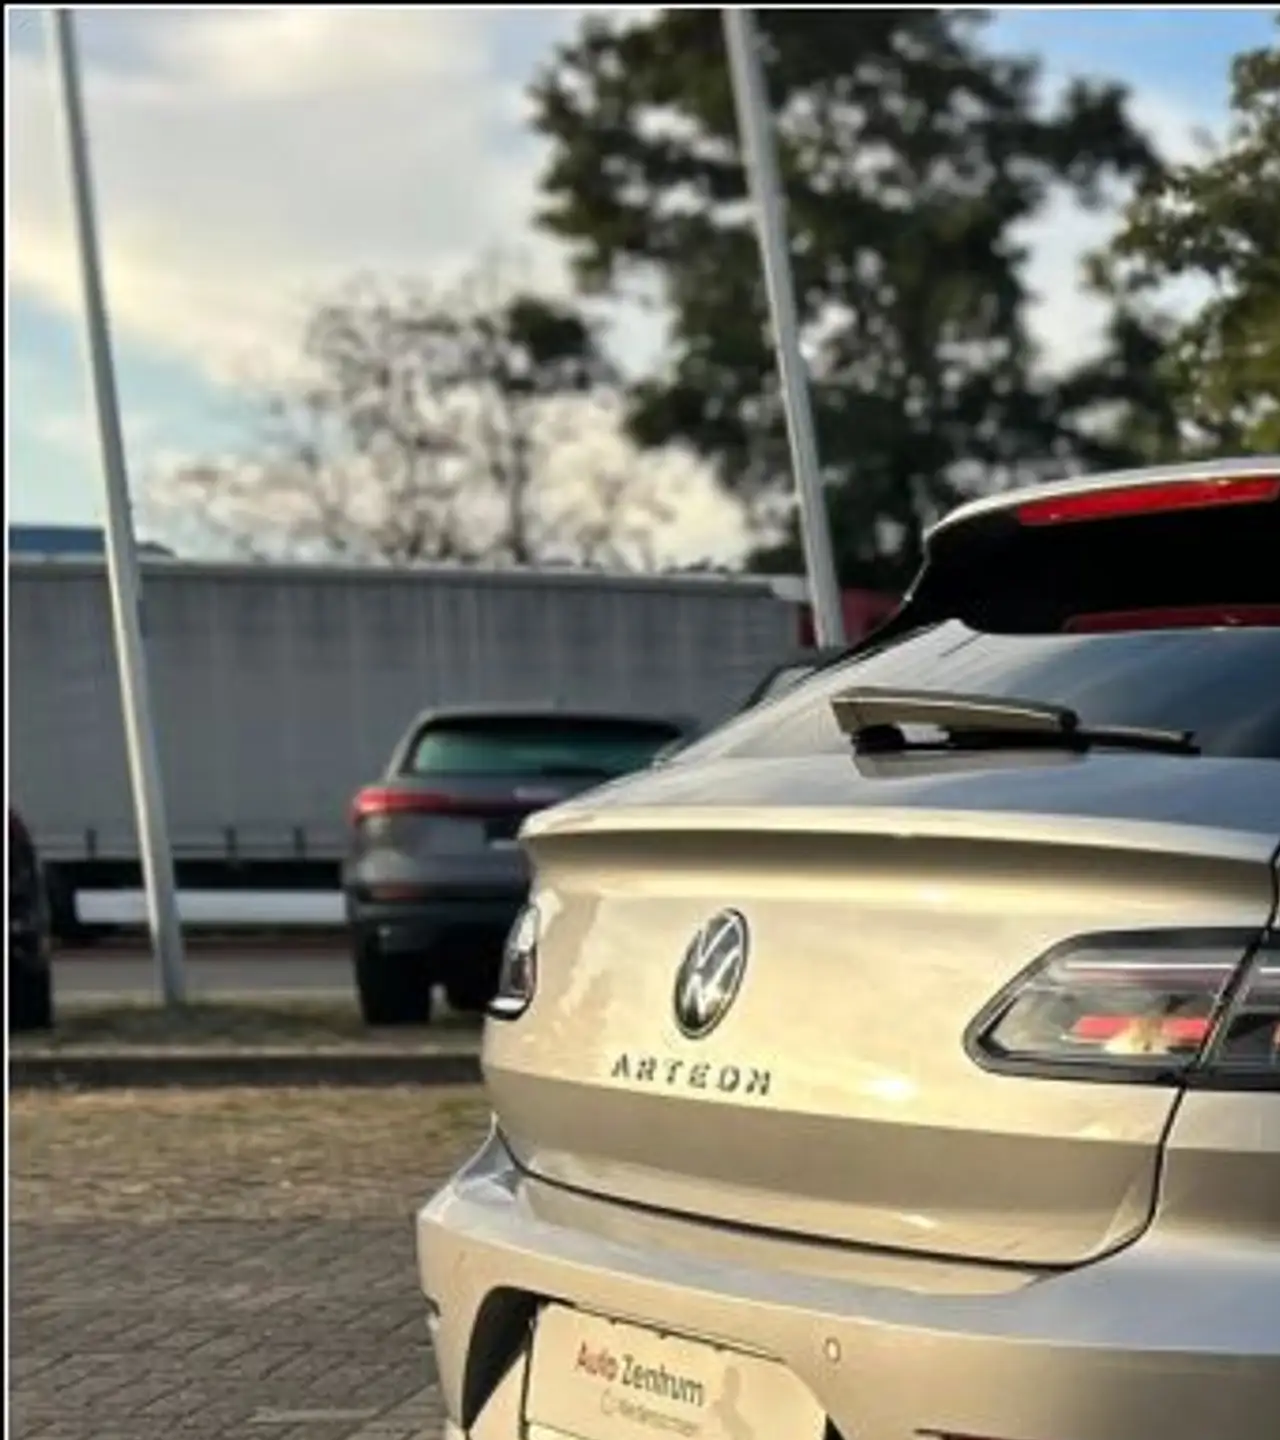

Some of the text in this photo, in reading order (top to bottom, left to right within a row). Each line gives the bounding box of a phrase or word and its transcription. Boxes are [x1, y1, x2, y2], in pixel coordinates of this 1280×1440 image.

[611, 1052, 771, 1096] ARTEON
[574, 1340, 706, 1408] Auto Zentrum
